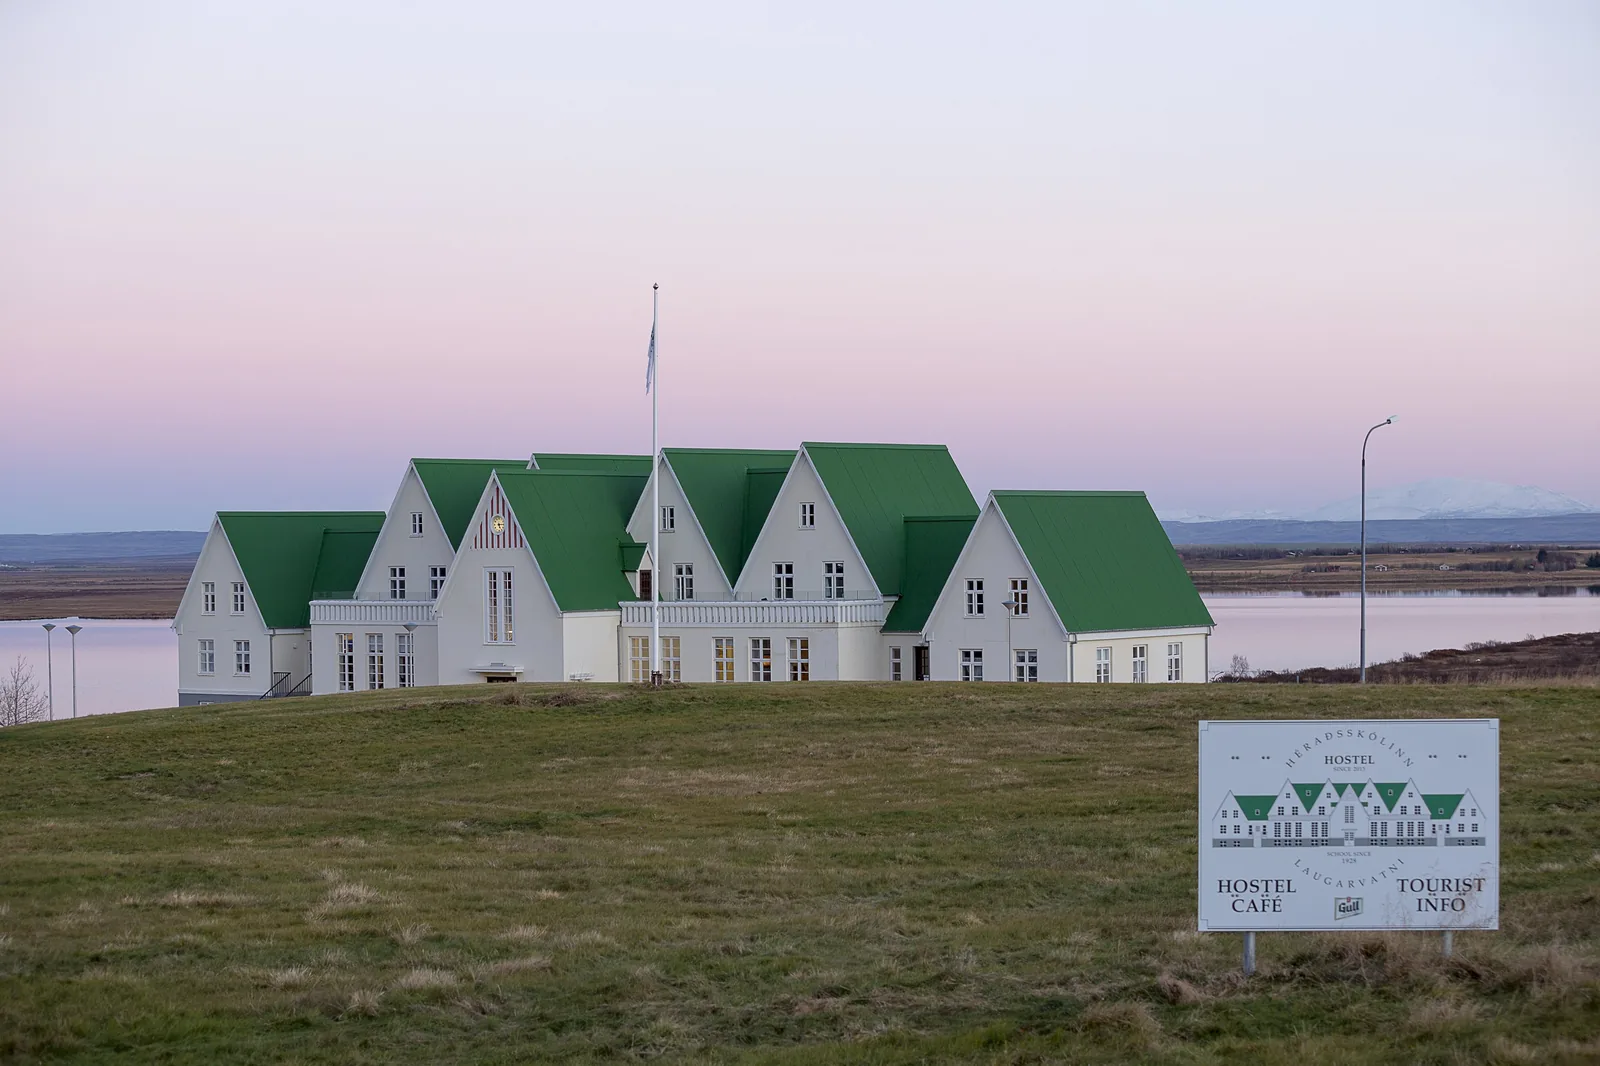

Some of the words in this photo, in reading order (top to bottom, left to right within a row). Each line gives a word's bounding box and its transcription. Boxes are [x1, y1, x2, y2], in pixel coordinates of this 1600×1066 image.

[1324, 755, 1375, 765] HOSTEL
[1294, 859, 1404, 888] LAUGARVATNI
[1217, 879, 1297, 893] HOSTEL
[1397, 878, 1486, 893] TOURIST
[1231, 895, 1282, 913] CAFÉ
[1338, 901, 1360, 913] Gull
[1416, 897, 1466, 912] INFO
